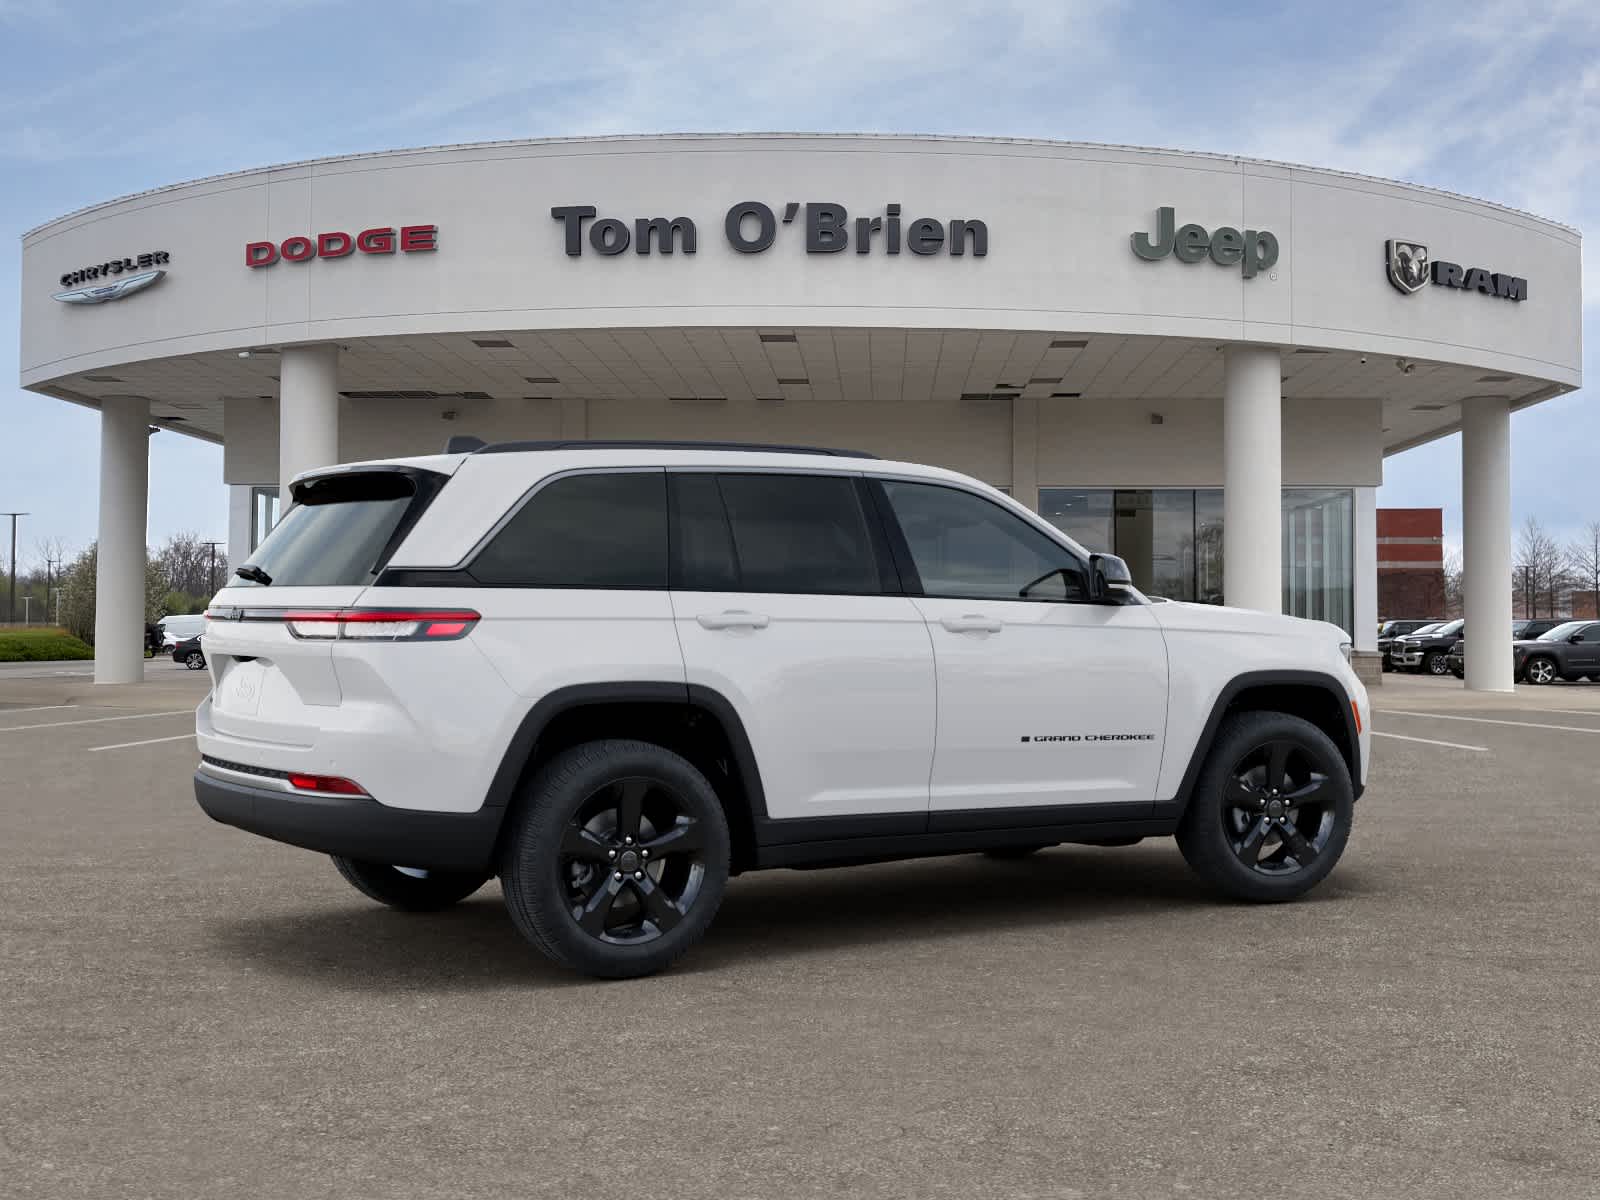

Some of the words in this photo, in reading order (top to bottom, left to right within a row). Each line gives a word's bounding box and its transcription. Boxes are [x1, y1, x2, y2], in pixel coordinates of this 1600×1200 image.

[245, 224, 438, 269] DODGE
[551, 205, 697, 257] Tom
[725, 200, 988, 257] O'Brien
[1130, 206, 1279, 279] Jeep
[60, 250, 170, 287] CHRYSLER
[1430, 260, 1528, 302] RAM
[1033, 734, 1082, 743] GRAND
[1084, 733, 1156, 742] CHEROKEE
